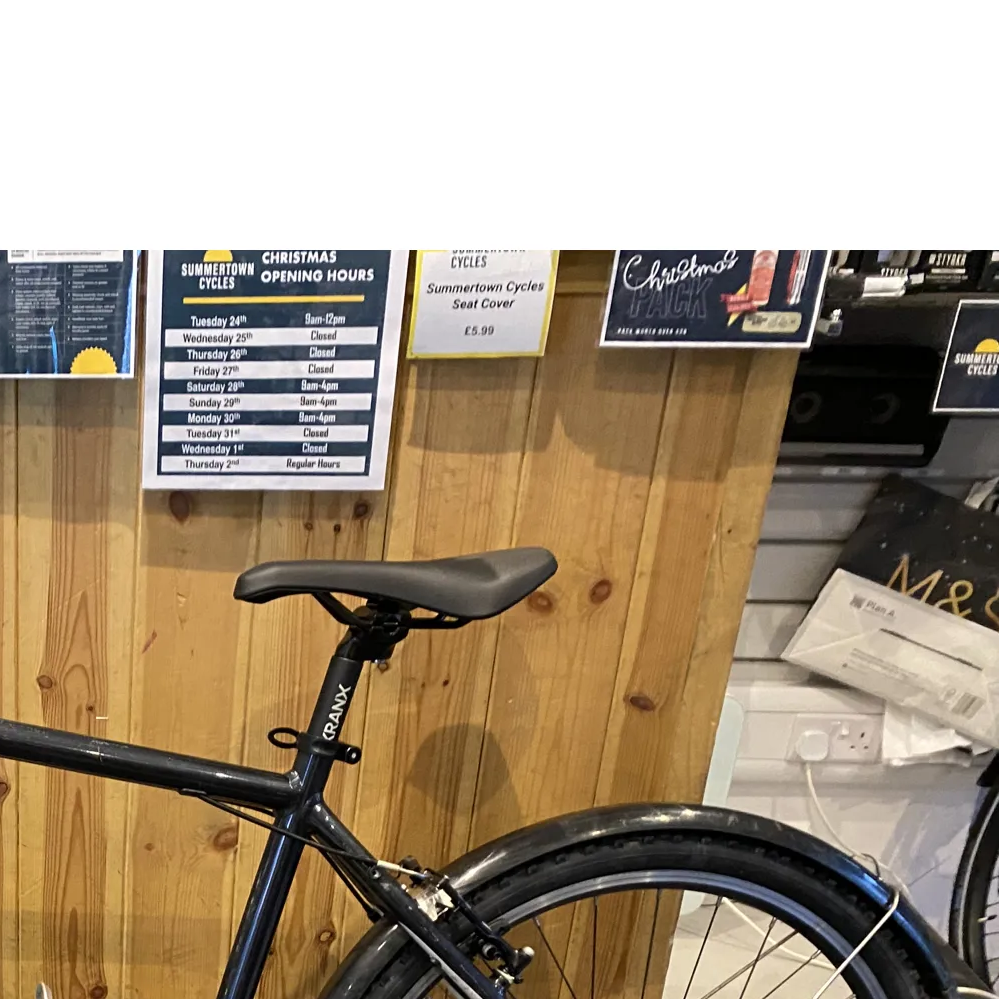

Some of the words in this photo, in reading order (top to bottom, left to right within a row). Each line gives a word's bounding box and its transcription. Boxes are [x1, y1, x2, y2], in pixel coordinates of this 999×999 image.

[262, 251, 337, 264] CHRISTMAS
[451, 255, 487, 269] CYCLES
[181, 262, 255, 277] SUMMERTOWN
[623, 250, 739, 291] Christmas
[261, 270, 323, 284] OPENING
[327, 269, 374, 282] HOURS
[199, 277, 235, 290] CYCLES
[427, 282, 503, 294] Summertown
[506, 280, 545, 295] Cycles
[452, 299, 478, 310] Seat
[481, 298, 516, 309] Cover
[629, 276, 713, 319] PACK
[191, 316, 227, 328] Tuesday
[229, 315, 247, 326] 24th
[305, 313, 346, 325] 9am-12pm
[183, 333, 234, 345] Wednesday
[236, 332, 253, 343] 25th
[310, 330, 337, 341] Closed
[464, 326, 495, 336] £5.99
[187, 349, 228, 361] Thursday
[230, 348, 247, 359] 26th
[309, 347, 336, 358] Closed
[193, 366, 220, 378] Friday
[222, 365, 240, 375] 27th
[308, 364, 334, 374] Closed
[967, 364, 998, 376] CYCLES
[187, 382, 226, 393] Saturday
[227, 381, 244, 392] 28th
[301, 381, 338, 392] 9am-4pm
[189, 398, 223, 409] Sunday
[224, 397, 240, 408] 29th
[300, 397, 337, 407] 9am-4pm
[187, 413, 222, 425] Monday
[223, 413, 240, 423] 30th
[299, 412, 336, 424] 9am-4pm
[187, 429, 220, 440] Tuesday
[221, 428, 240, 438] 31st
[303, 427, 329, 437] Closed
[181, 444, 231, 455] Wednesday
[233, 443, 244, 454] 1st
[302, 443, 328, 453] Closed
[185, 459, 224, 470] Thursday
[226, 459, 240, 468] 2nd
[286, 459, 316, 470] Regular
[317, 459, 341, 468] Hours
